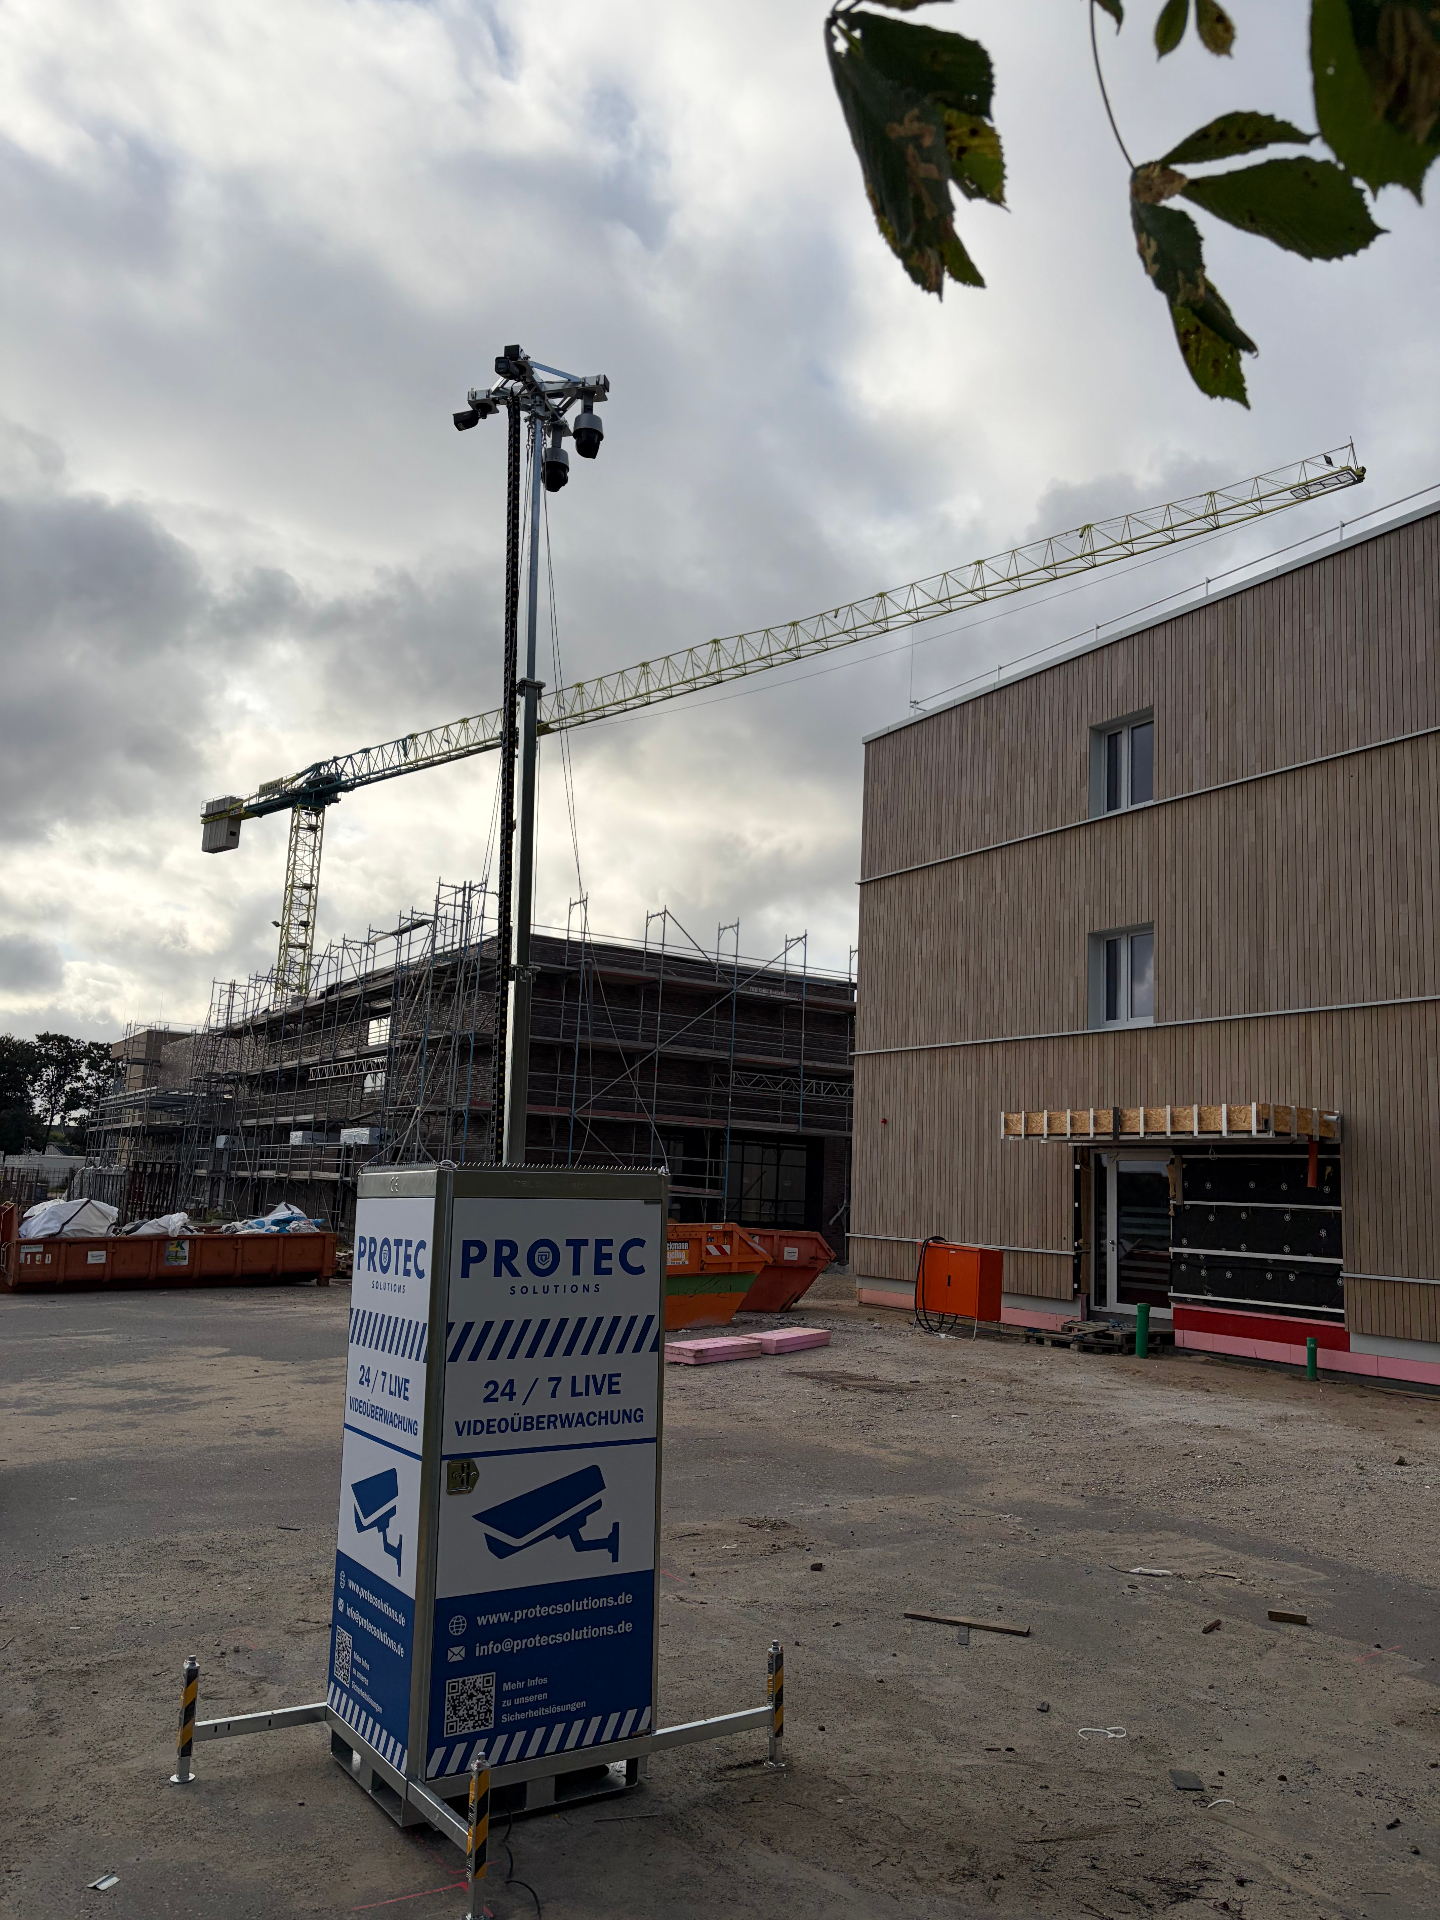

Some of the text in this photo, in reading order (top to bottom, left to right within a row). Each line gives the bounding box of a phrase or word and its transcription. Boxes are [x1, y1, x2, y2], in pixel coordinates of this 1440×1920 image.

[357, 1235, 427, 1280] PROTEC
[460, 1237, 647, 1279] PROTEC
[667, 1241, 689, 1251] ckmann
[371, 1280, 406, 1294] SOLUTIONS
[509, 1283, 600, 1295] SOLUTIONS
[358, 1364, 410, 1402] 24 / 7 LIVE
[482, 1372, 622, 1406] 24 / 7 LIVE
[349, 1395, 419, 1437] VIDEOÜBERWACHUNG
[454, 1407, 644, 1437] VIDEOÜBERWACHUNG
[347, 1578, 406, 1627] www.protecsolutions.de
[476, 1591, 633, 1627] www.protecsolutions.de
[346, 1602, 405, 1658] info@protecsolutions.de
[475, 1620, 633, 1657] info@protecsolutions.de
[501, 1692, 548, 1708] zu unseren
[502, 1676, 548, 1692] Mehr Infos
[501, 1700, 586, 1723] Sicherheitslösungen
